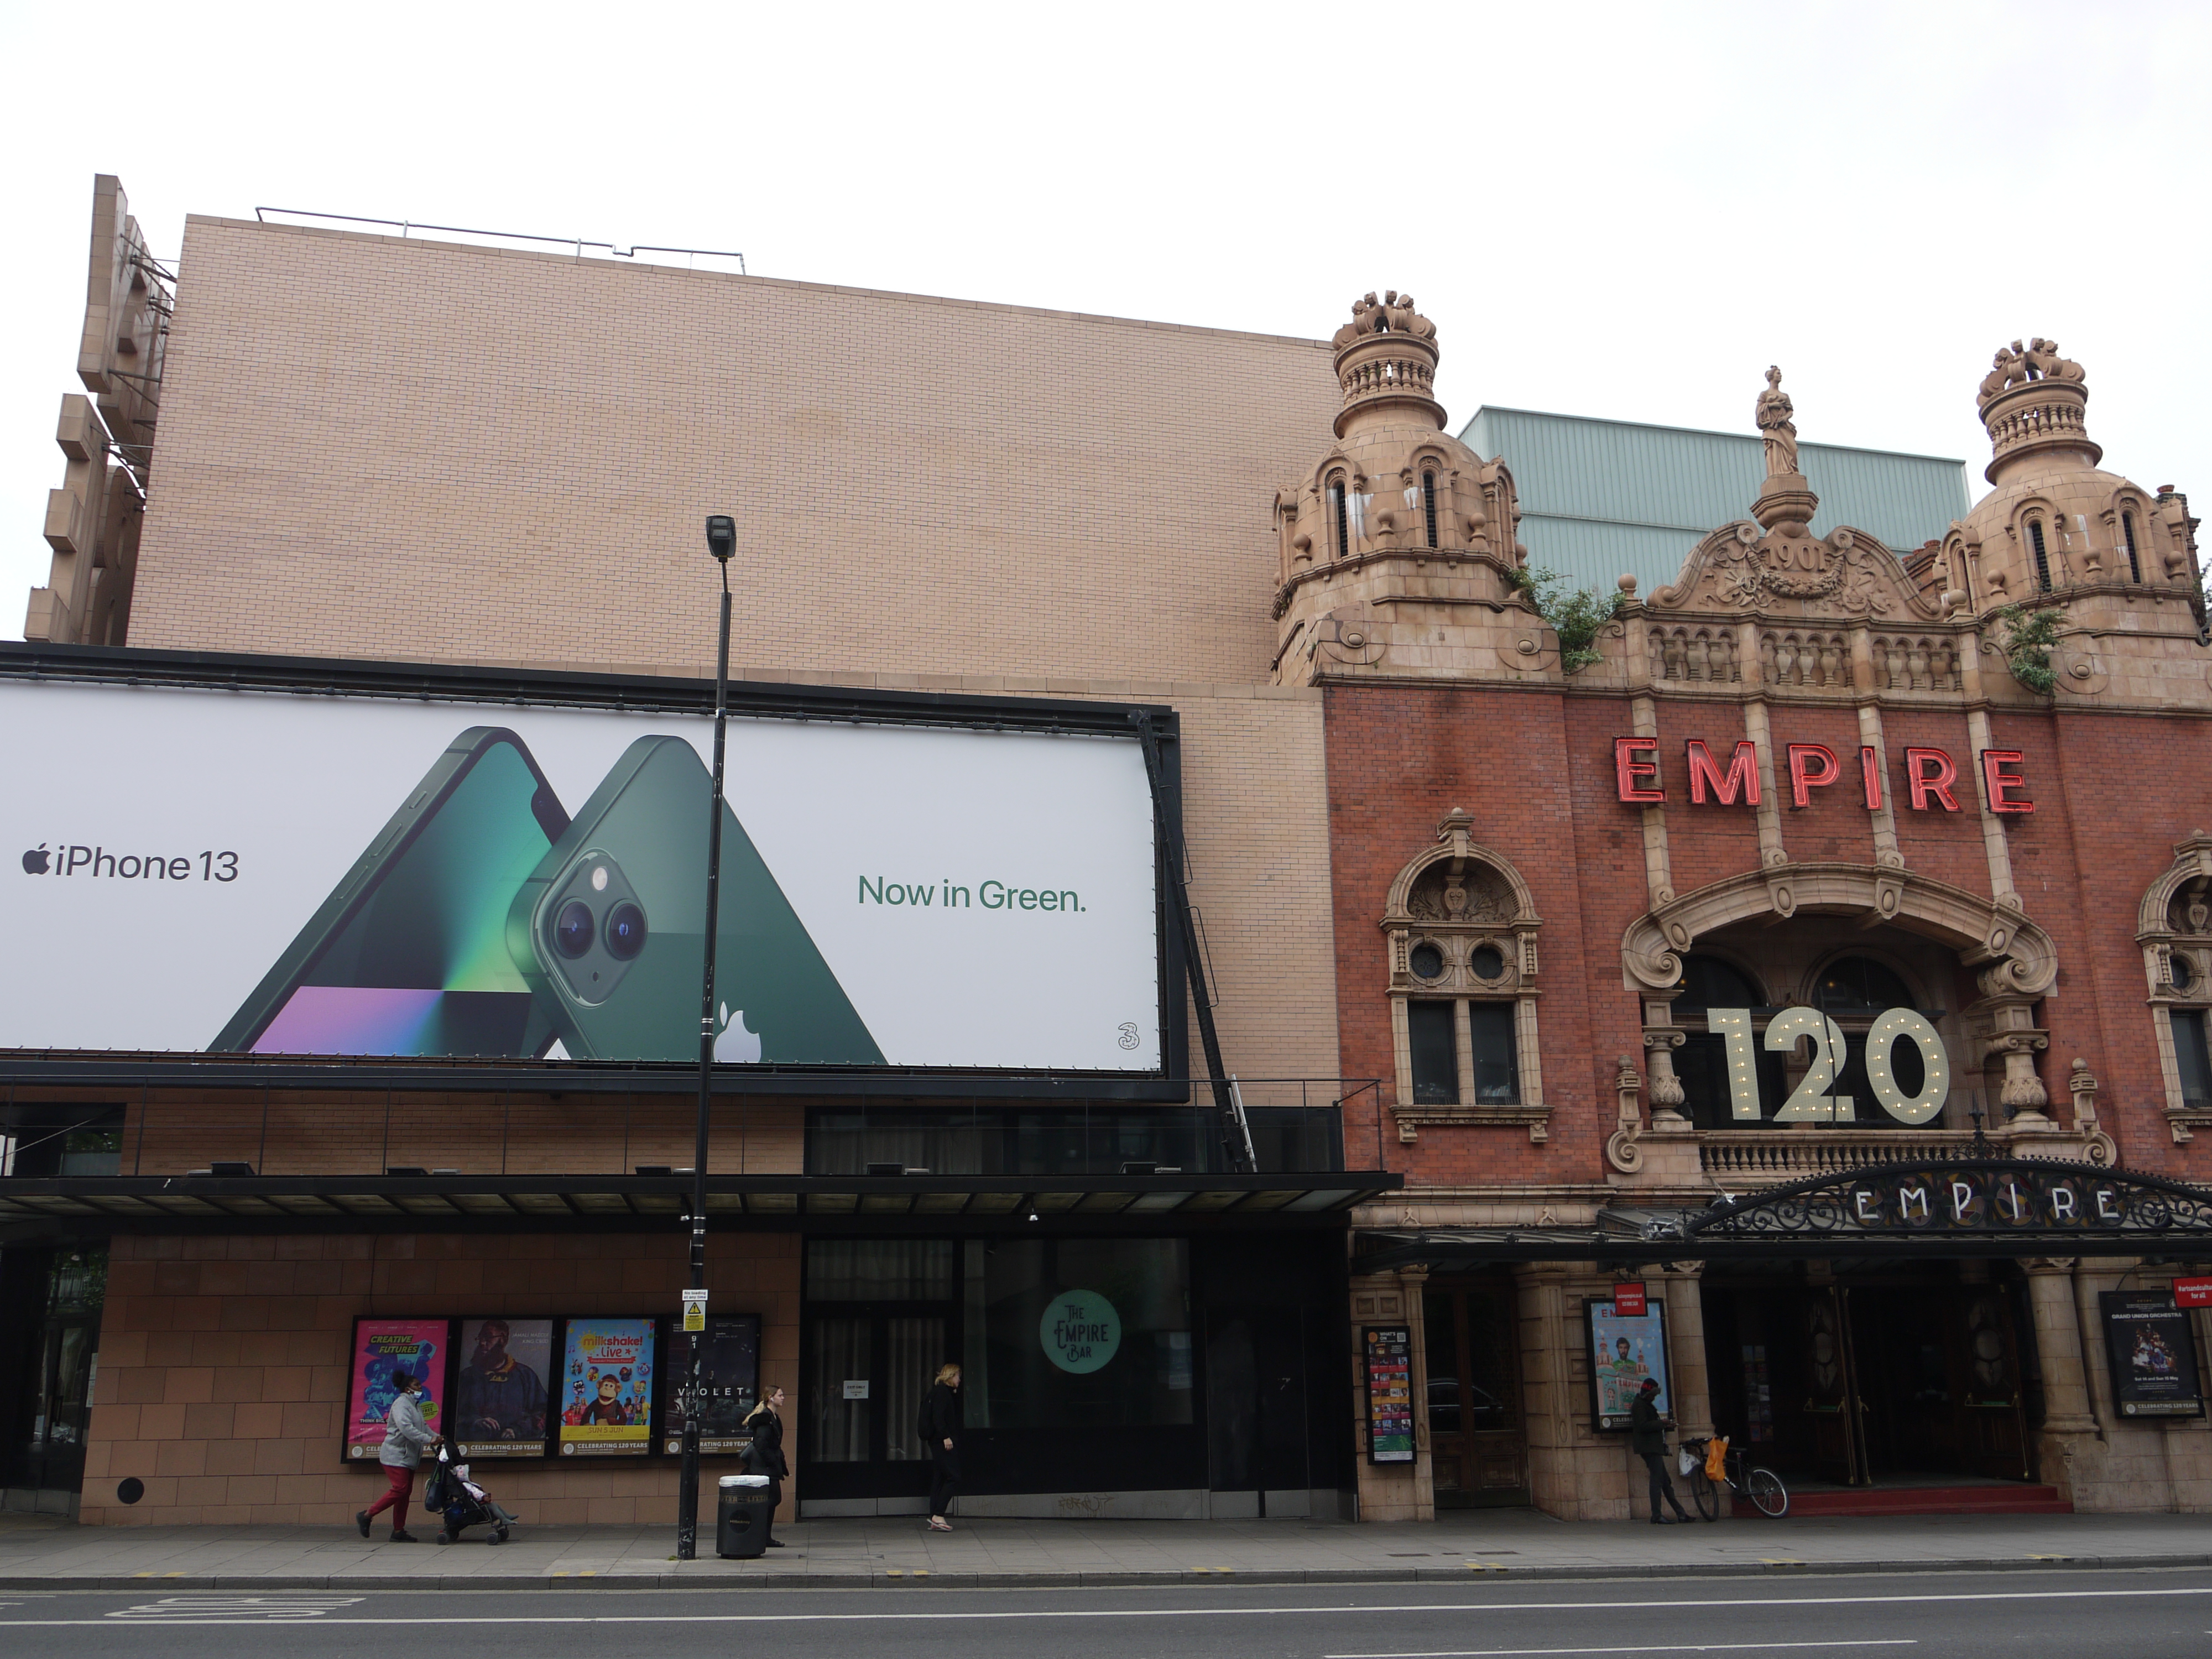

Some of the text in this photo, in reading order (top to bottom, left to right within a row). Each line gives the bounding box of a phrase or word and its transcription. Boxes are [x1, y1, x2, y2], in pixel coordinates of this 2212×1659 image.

[1764, 542, 1828, 571] 1901
[1612, 736, 2036, 815] EMPIRE
[55, 844, 239, 883] iPhone 13
[858, 875, 1087, 912] Now in Green.
[1706, 1006, 1950, 1125] 120
[1855, 1182, 2122, 1220] EMPIRE
[370, 1335, 413, 1344] CREATIVE
[583, 1335, 643, 1346] milkshake!
[677, 1387, 743, 1396] VOLET
